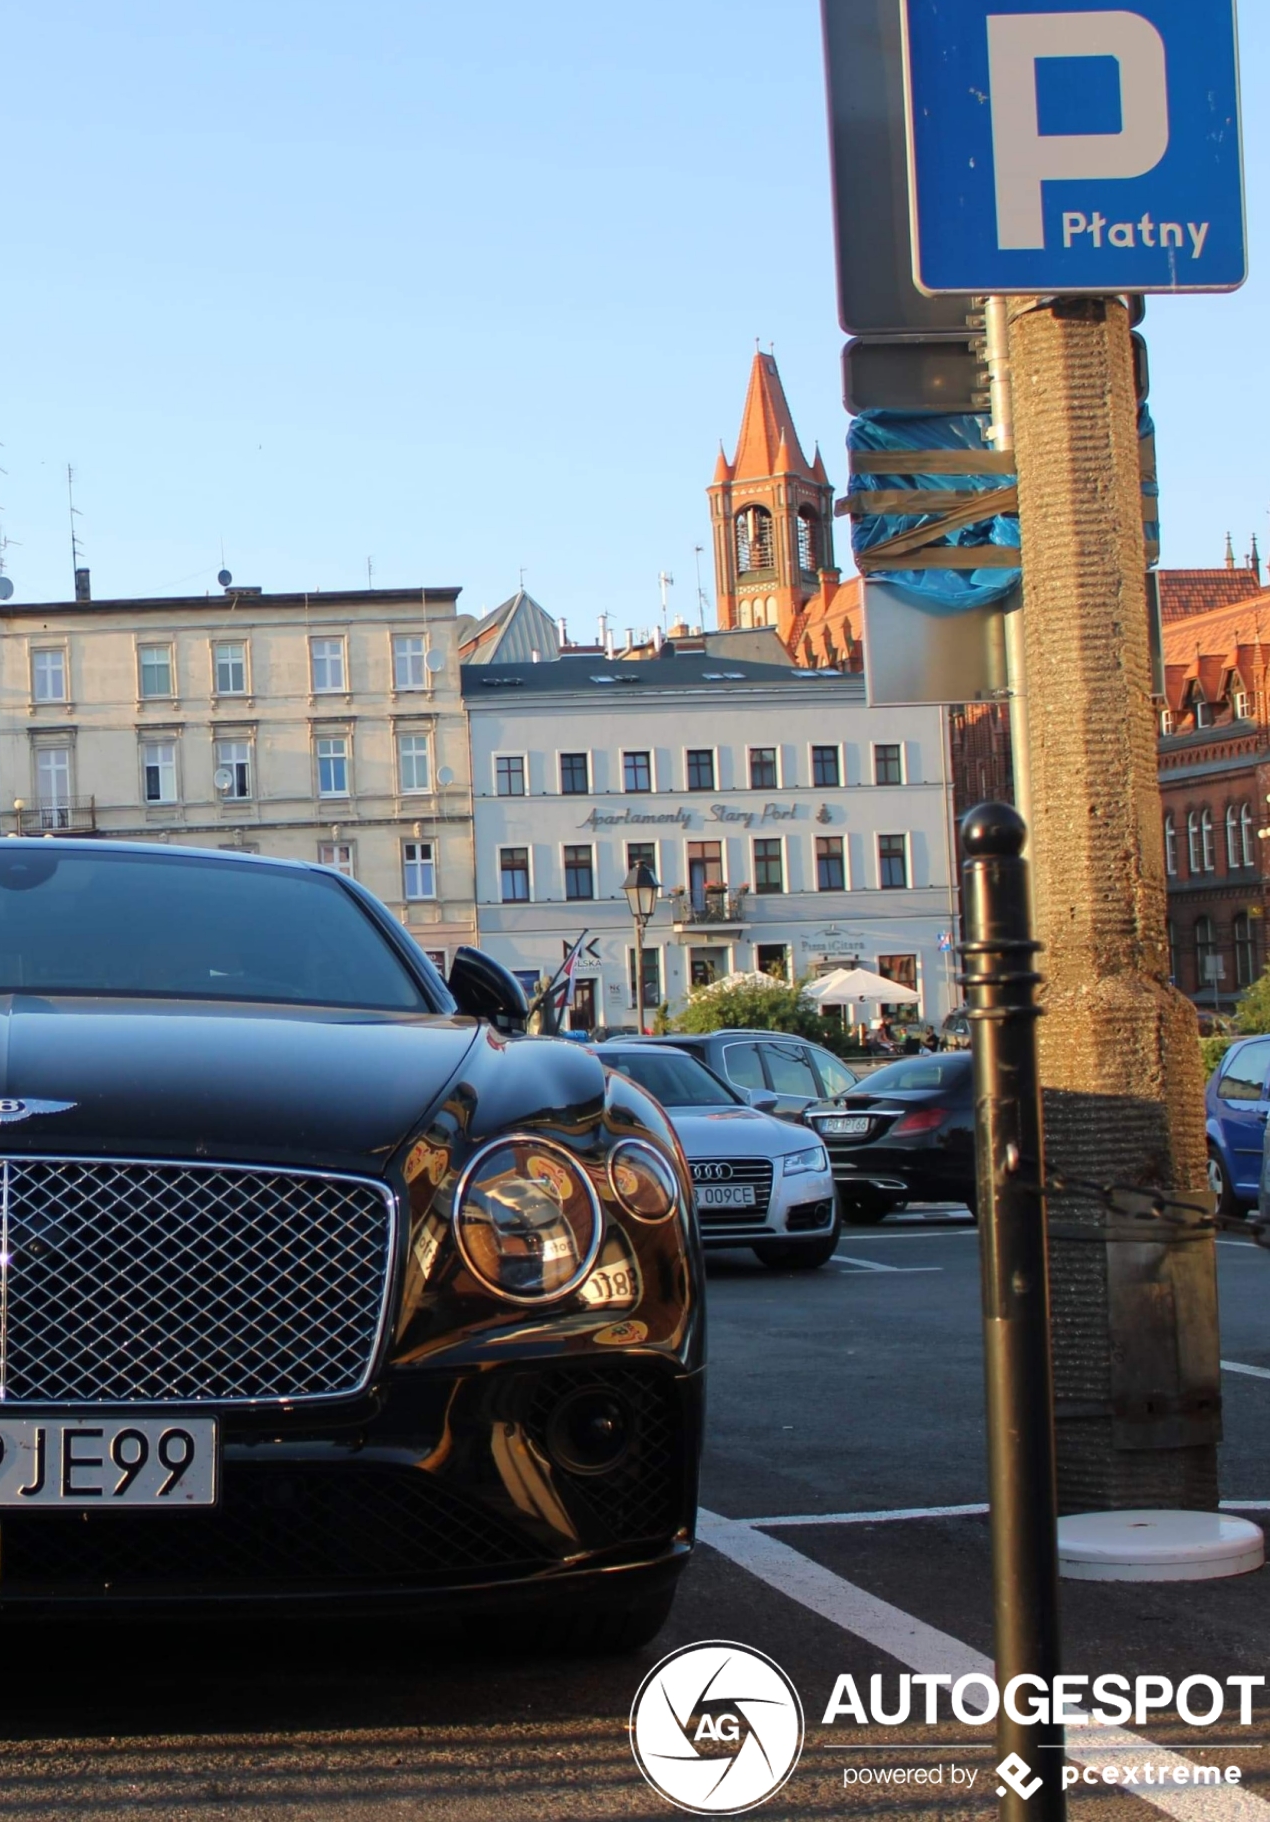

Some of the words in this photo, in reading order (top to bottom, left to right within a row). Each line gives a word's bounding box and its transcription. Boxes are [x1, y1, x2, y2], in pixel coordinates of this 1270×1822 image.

[986, 10, 1170, 250] P
[1062, 211, 1210, 259] Płatny
[575, 807, 692, 832] Apartamenty
[704, 803, 754, 829] Stary
[761, 802, 797, 824] Port
[704, 1187, 752, 1204] 009CE
